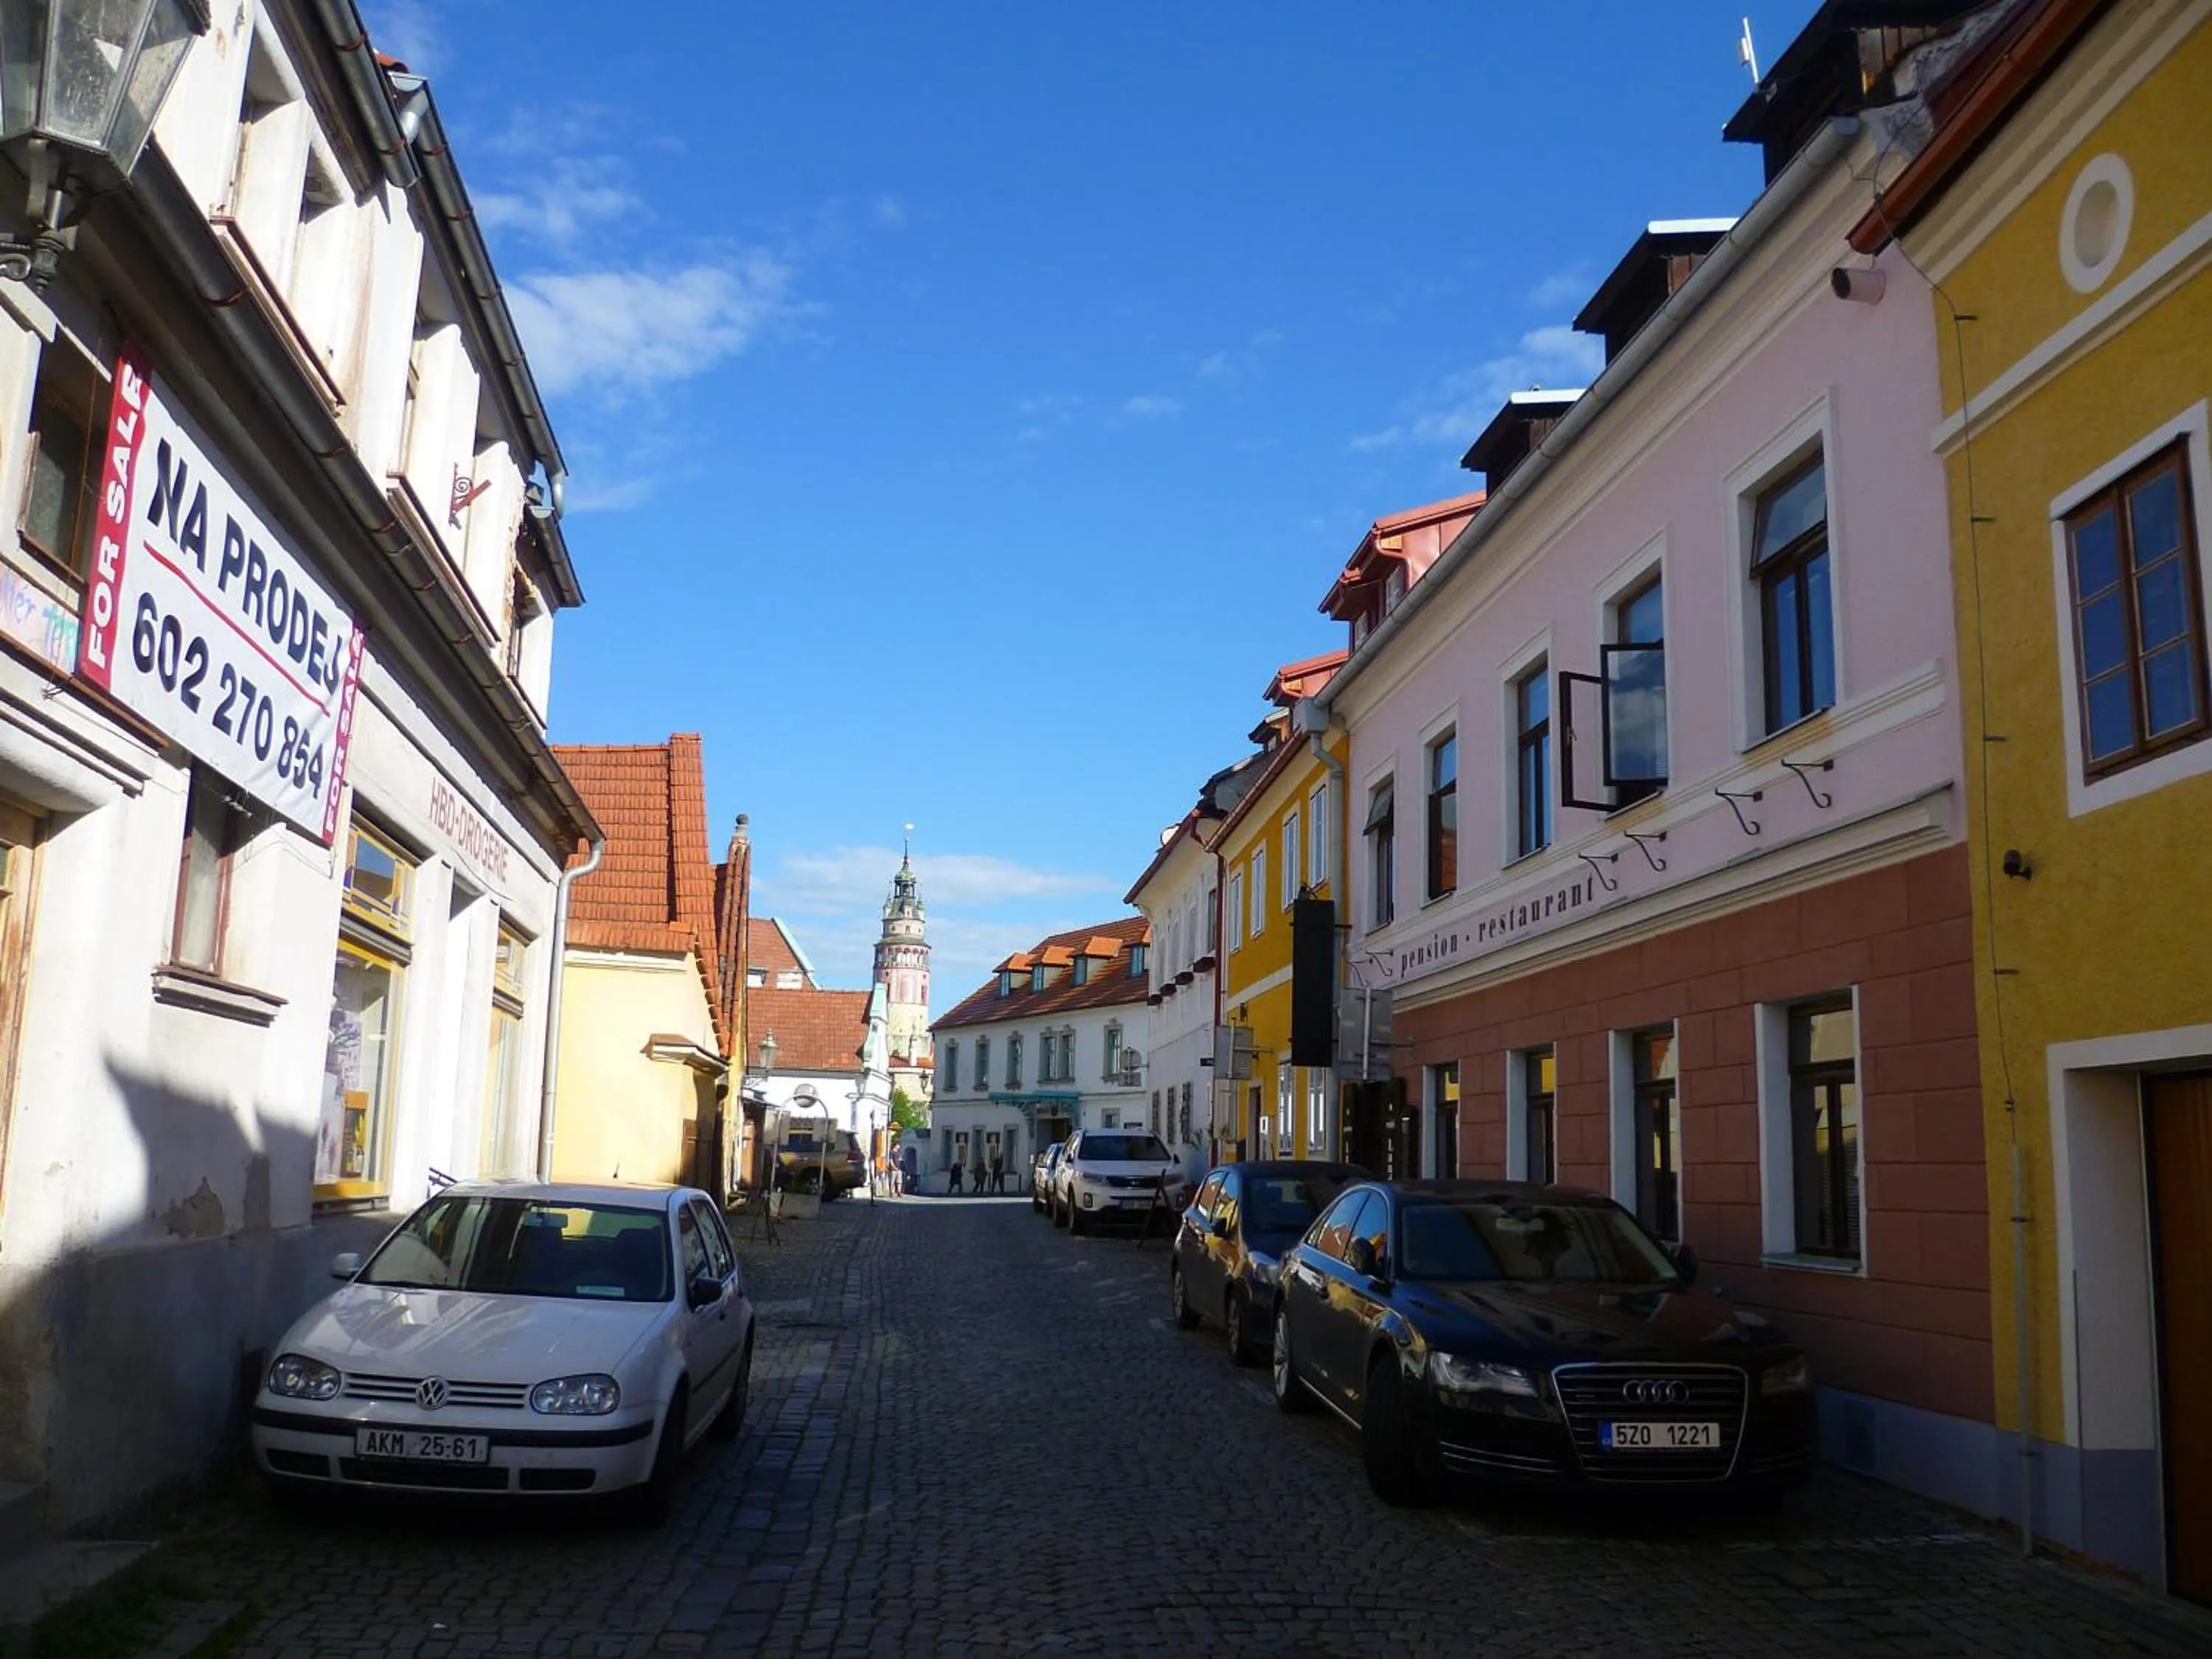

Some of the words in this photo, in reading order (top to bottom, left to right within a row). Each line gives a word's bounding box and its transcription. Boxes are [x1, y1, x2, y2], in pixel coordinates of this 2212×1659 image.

[88, 535, 120, 669] FOR
[108, 364, 144, 525] SALE
[147, 437, 208, 574] NA
[218, 512, 343, 695] PRODEJ
[133, 592, 209, 714] 602
[212, 663, 274, 761] 270
[276, 715, 323, 799] 854
[325, 745, 344, 832] FOR
[430, 776, 507, 883] HBD-DROGERIE
[1401, 933, 1457, 978] pension
[1478, 873, 1593, 943] restaurant
[366, 1431, 404, 1454] AKM
[1666, 1425, 1711, 1444] 1221
